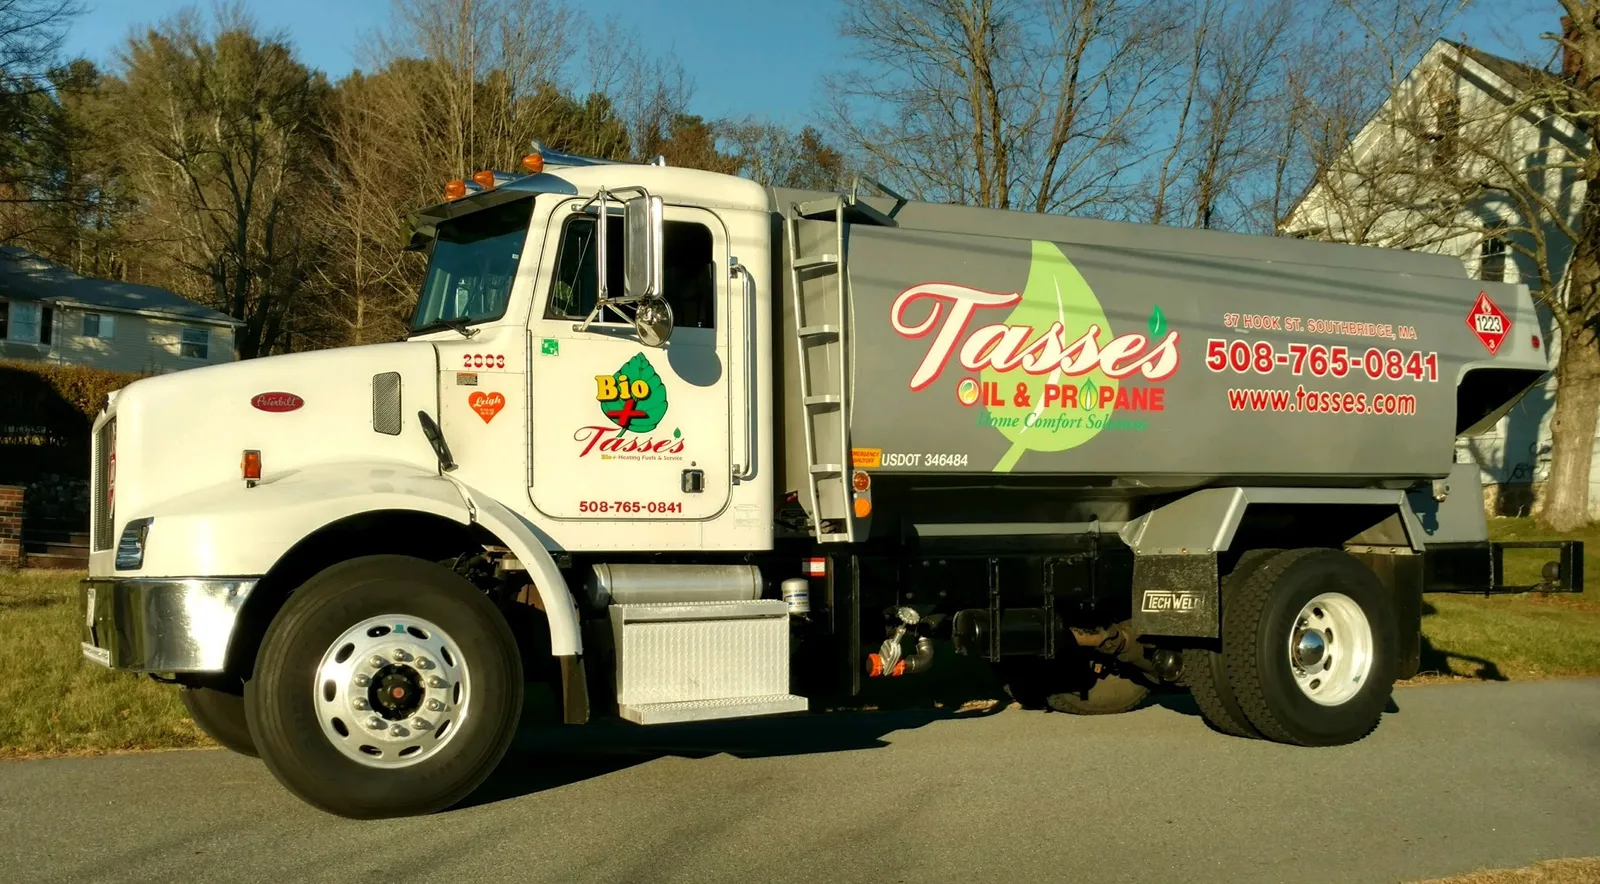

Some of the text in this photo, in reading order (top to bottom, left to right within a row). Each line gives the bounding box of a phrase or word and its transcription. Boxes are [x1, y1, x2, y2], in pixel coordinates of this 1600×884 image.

[1224, 313, 1417, 340] 37 HOOK ST. SOUTHBRIDGE, MA
[1477, 315, 1501, 332] 1223
[890, 281, 1181, 392] Tasse's
[1488, 339, 1496, 349] 3
[463, 353, 505, 369] 2003
[1205, 338, 1438, 382] 508-765-0841
[595, 374, 651, 402] Bio
[957, 377, 1166, 412] OIL & PROPANE
[256, 395, 297, 407] Peterbilt
[473, 395, 501, 408] Leigh
[1228, 384, 1416, 415] www.tasses.com
[976, 411, 1019, 428] Home
[1024, 412, 1083, 433] Comfort
[573, 425, 685, 457] Tasse's
[881, 453, 968, 466] USDOT 346484
[579, 501, 682, 513] 508-765-0841
